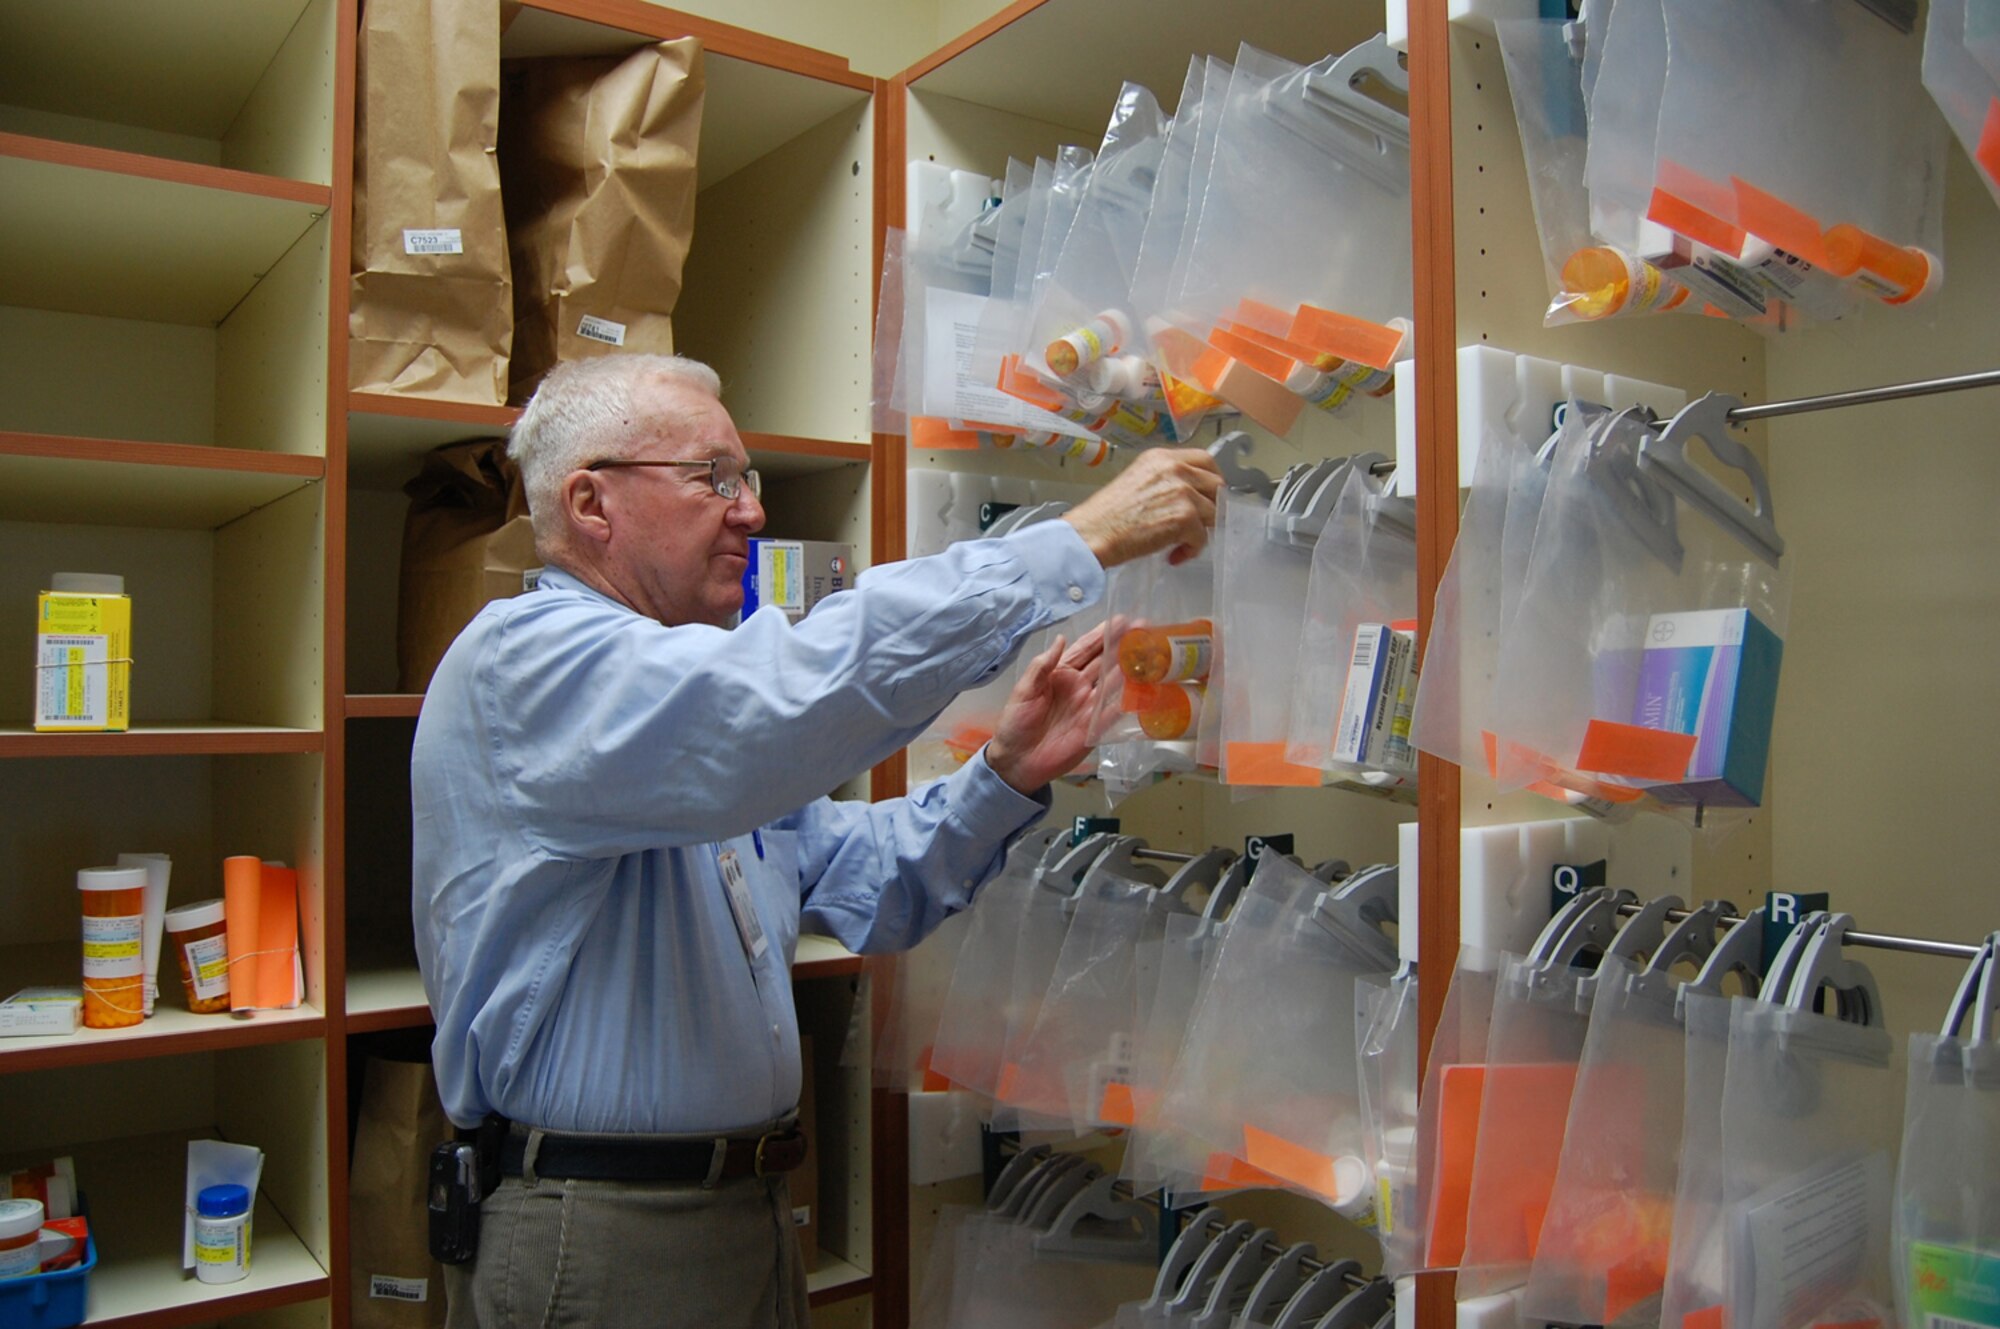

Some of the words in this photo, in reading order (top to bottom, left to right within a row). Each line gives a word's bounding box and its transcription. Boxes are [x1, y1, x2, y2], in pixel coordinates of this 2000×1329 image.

[981, 503, 991, 522] C
[831, 577, 843, 593] B
[1075, 816, 1086, 836] F
[1248, 837, 1264, 860] G
[1554, 866, 1578, 894] Q
[1772, 892, 1796, 924] R
